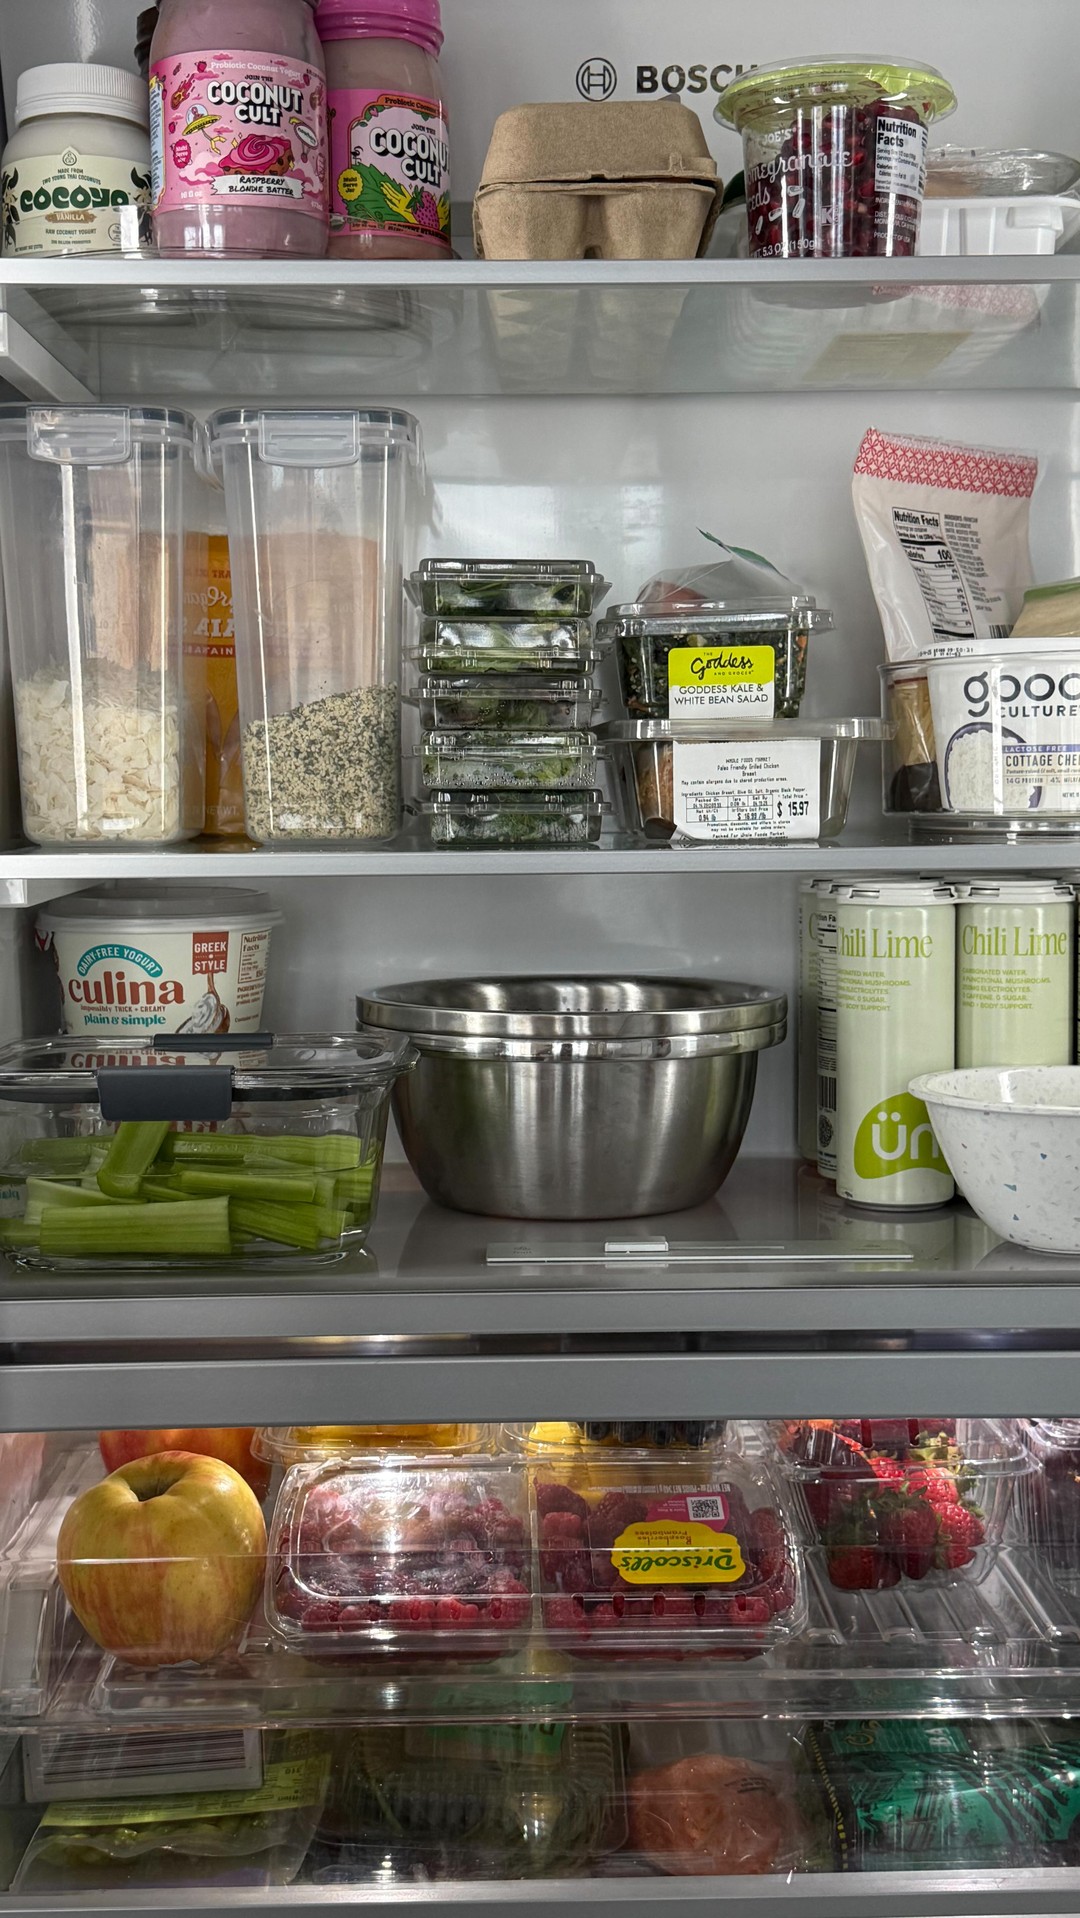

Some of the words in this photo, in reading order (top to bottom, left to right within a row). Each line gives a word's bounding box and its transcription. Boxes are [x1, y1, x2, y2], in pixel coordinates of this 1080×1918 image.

[245, 74, 260, 82] JOIN
[261, 75, 274, 83] THE
[637, 64, 757, 93] BOSC
[207, 80, 304, 114] COCONUT
[385, 97, 415, 108] Probiotic
[235, 103, 283, 127] CULT
[877, 119, 917, 139] Nutrition
[877, 131, 905, 149] Facts
[401, 157, 442, 188] CULT
[239, 175, 286, 187] RASPBERRY
[228, 185, 264, 194] BLONDIE
[266, 185, 295, 197] BATTER
[55, 212, 85, 222] VANILLA
[894, 511, 921, 525] Nutrition
[921, 514, 939, 528] Facts
[937, 549, 952, 561] 100
[691, 651, 753, 681] Goddess
[679, 685, 728, 695] GODDESS
[730, 683, 754, 693] KALE
[756, 683, 764, 692] &
[674, 696, 705, 706] WHITE
[708, 695, 734, 705] BEAN
[737, 693, 769, 703] SALAD
[1004, 745, 1043, 753] LACTOSE
[730, 764, 748, 772] Friendly
[1005, 755, 1053, 767] COTTAGE
[1057, 753, 1080, 766] CHE
[777, 801, 783, 818] $
[788, 801, 809, 817] 15.97
[194, 941, 227, 953] GREEK
[837, 925, 866, 957] hili
[871, 928, 934, 958] Lime
[962, 925, 1008, 956] Chili
[1013, 926, 1067, 956] Lime
[124, 948, 161, 975] YOGURT
[194, 959, 226, 972] STYLE
[68, 971, 186, 1006] culina
[140, 1005, 166, 1013] CREAMY
[84, 1012, 112, 1026] plain
[111, 1015, 120, 1024] &
[121, 1013, 167, 1028] simple
[621, 1554, 737, 1572] Driscoll's
